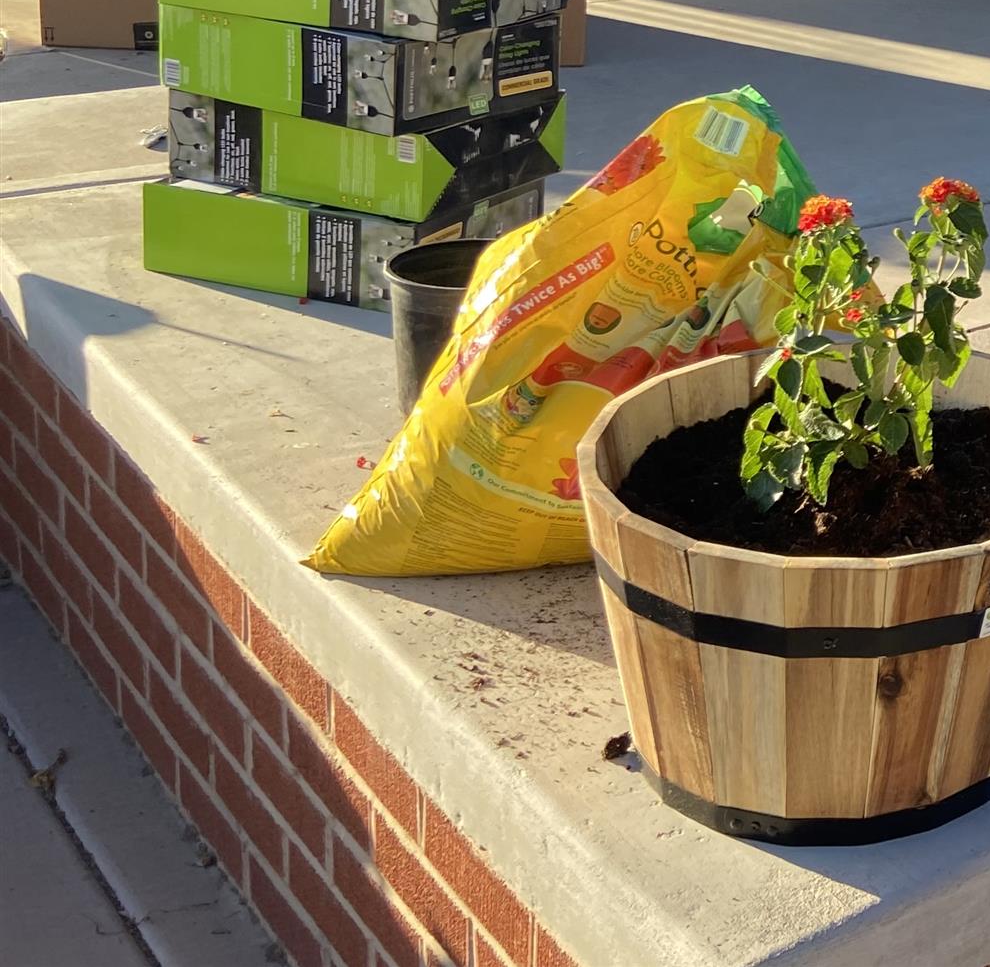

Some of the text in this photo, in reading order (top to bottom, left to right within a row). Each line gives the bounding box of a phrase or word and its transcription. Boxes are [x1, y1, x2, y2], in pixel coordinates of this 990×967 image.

[471, 100, 487, 109] LED
[512, 285, 556, 316] Twice
[557, 271, 577, 288] As
[575, 251, 605, 276] Big!
